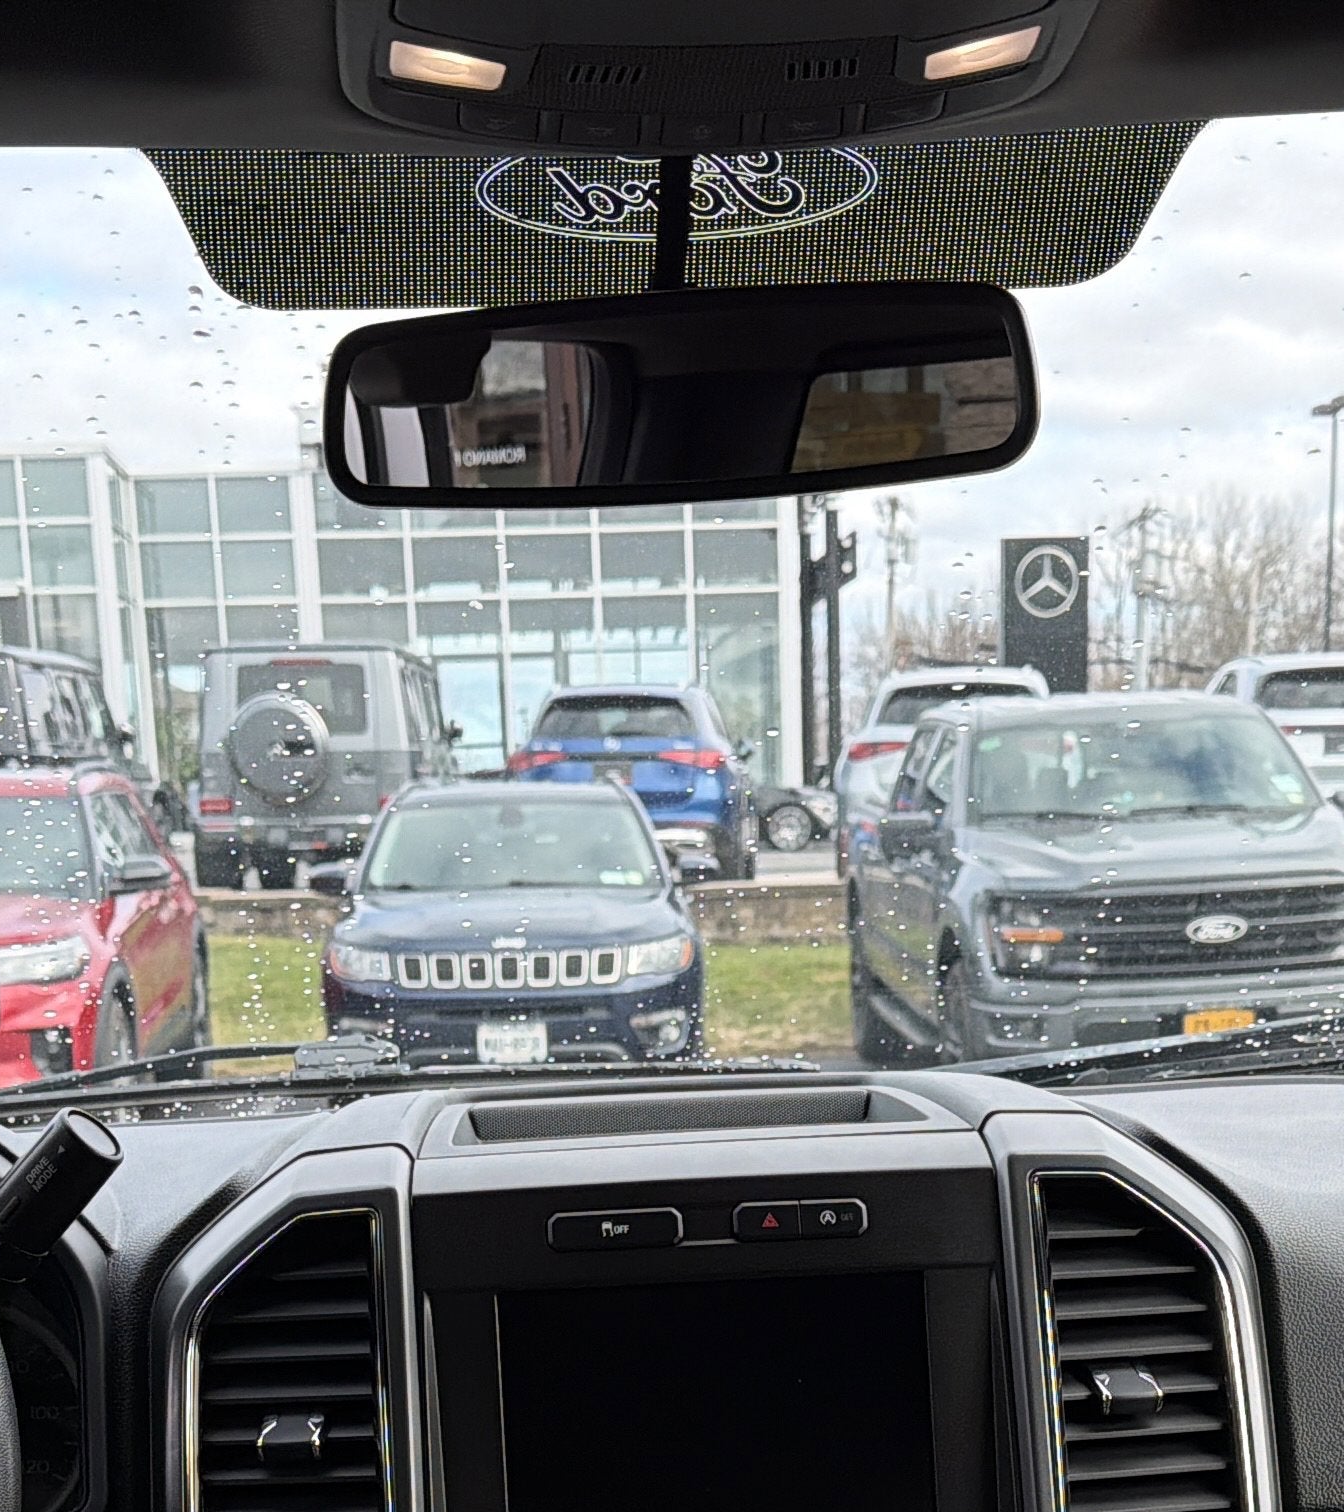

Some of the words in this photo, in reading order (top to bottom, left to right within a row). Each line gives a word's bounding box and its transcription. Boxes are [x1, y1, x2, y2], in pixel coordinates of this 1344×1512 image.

[26, 1156, 50, 1184] DRIVE
[32, 1163, 58, 1192] MODE
[614, 1224, 629, 1234] OFF
